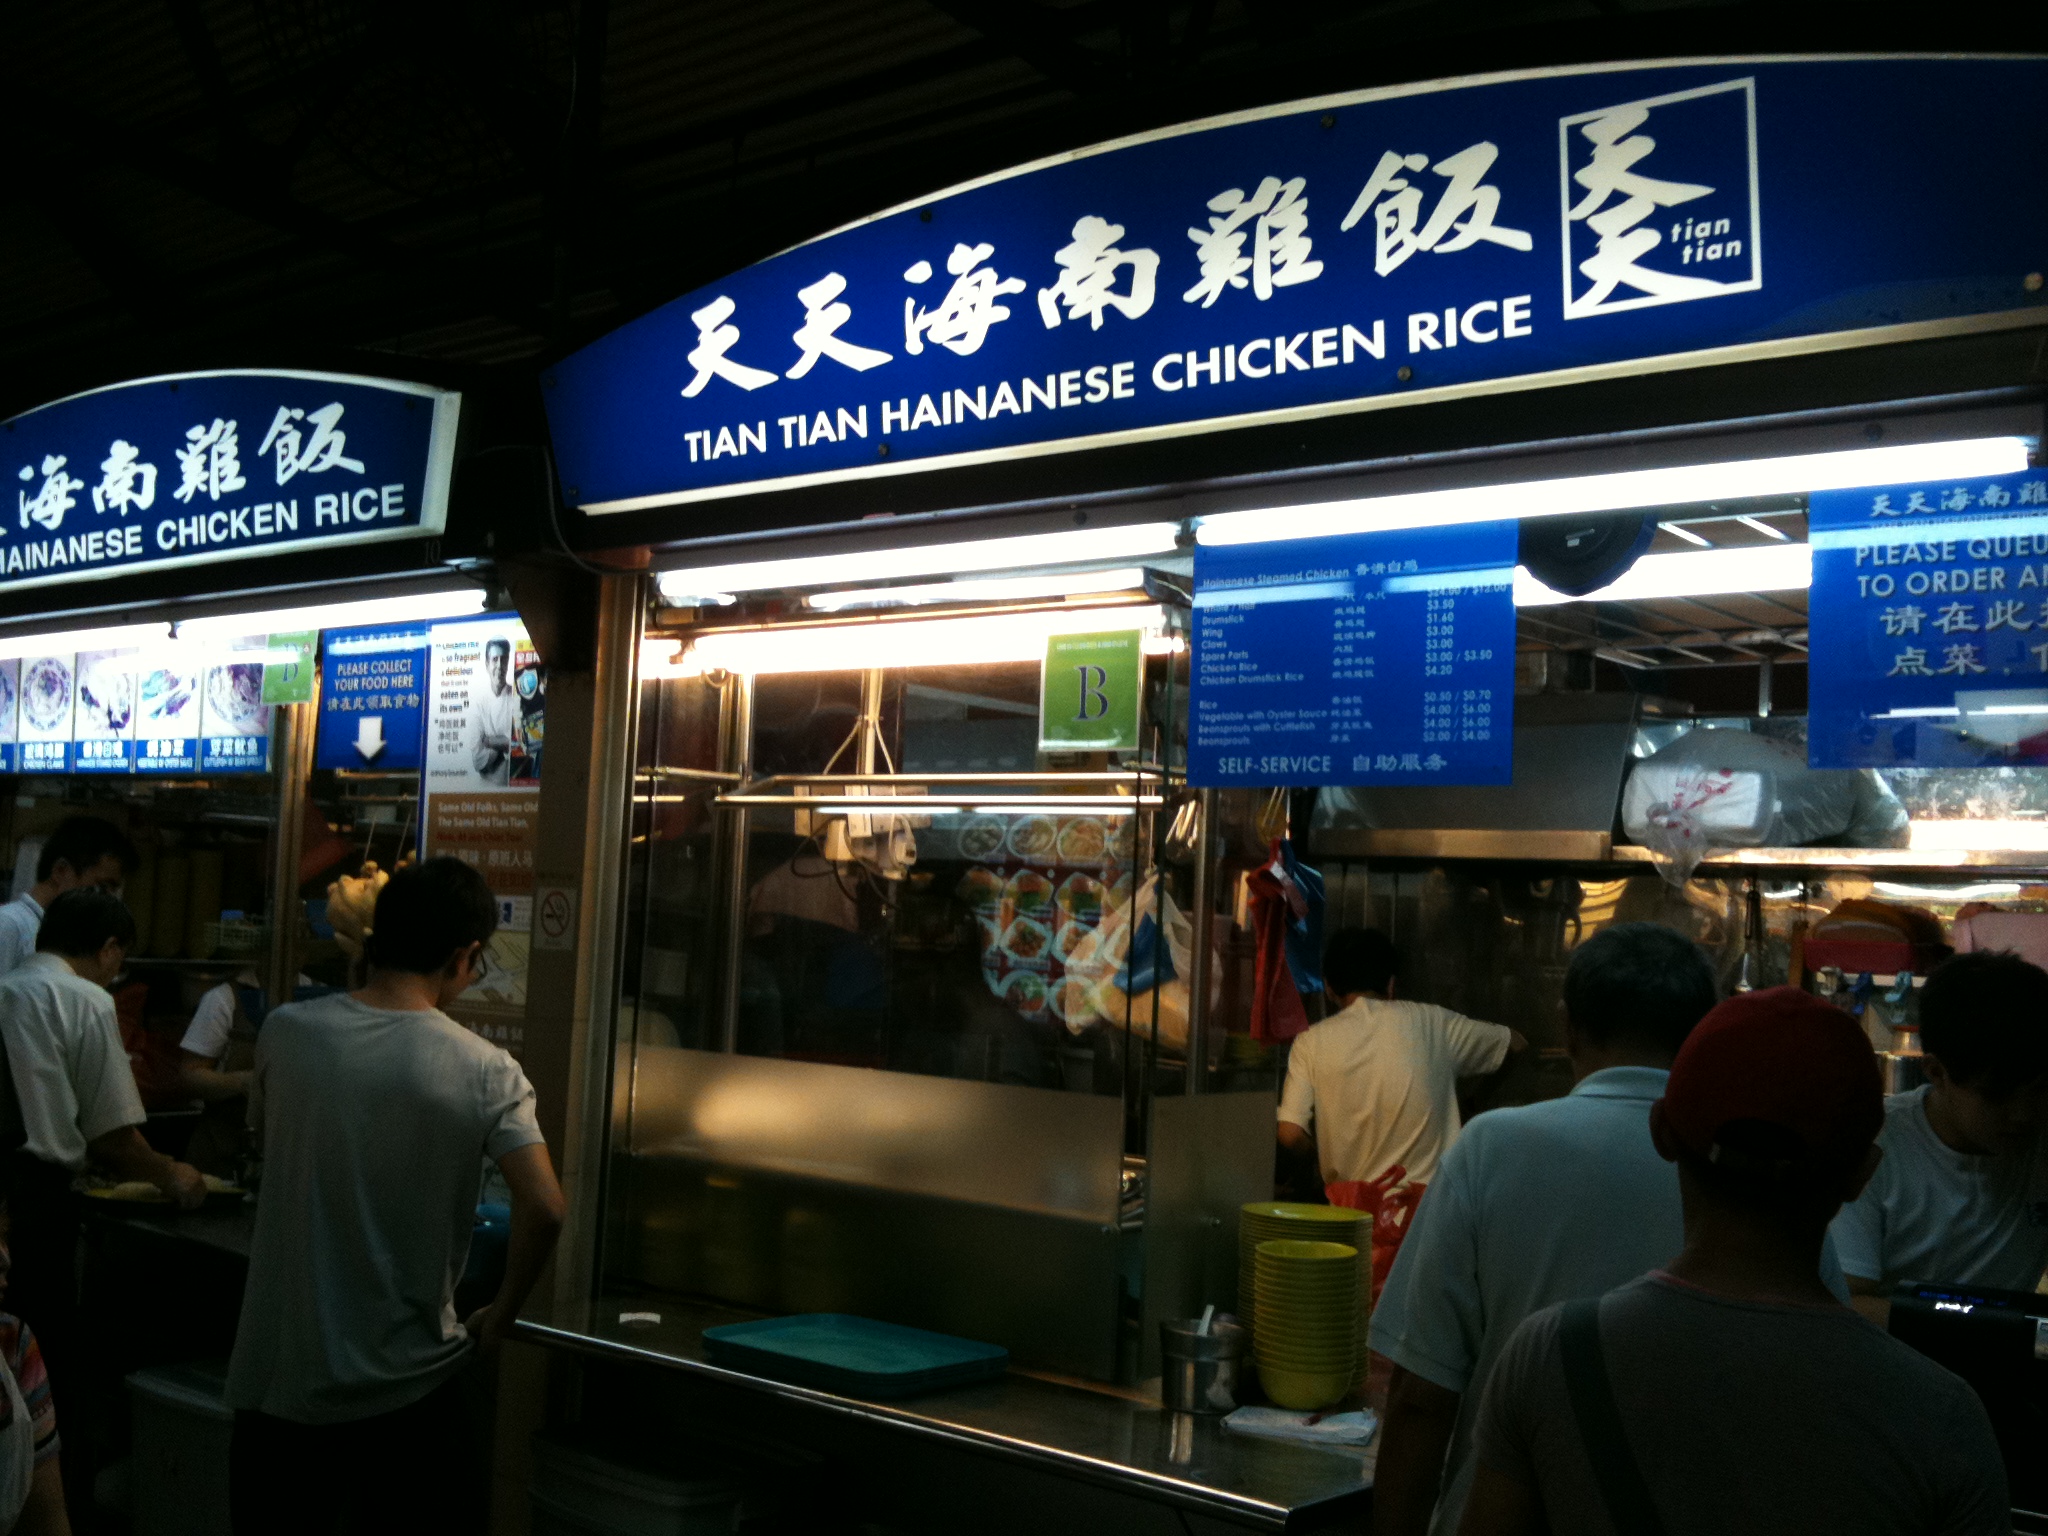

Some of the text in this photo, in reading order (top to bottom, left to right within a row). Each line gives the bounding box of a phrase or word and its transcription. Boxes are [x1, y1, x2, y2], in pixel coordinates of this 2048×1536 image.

[1671, 217, 1730, 243] tian
[1682, 239, 1742, 264] tian
[681, 141, 1533, 398] 天天海南雞飯
[684, 295, 1533, 463] TIAN TIAN HAINANESE CHICKEN RICE
[0, 402, 365, 536] 海南雞飯
[0, 484, 405, 575] AINANESE CHICKEN RICE
[1855, 541, 1956, 567] PLEASE
[1203, 575, 1254, 588] Hainanese
[1257, 571, 1302, 584] Steamed
[1305, 568, 1349, 580] Chicken
[1857, 572, 1895, 598] TO
[1906, 567, 2006, 595] ORDER
[1202, 614, 1244, 626] Drumstick
[1202, 628, 1223, 639] Wing
[1426, 625, 1454, 638] $3.00
[1201, 639, 1227, 649] Claws
[1425, 638, 1453, 651] $3.00
[1201, 650, 1249, 663] Spare Parts
[1425, 651, 1453, 664] $3.00
[337, 658, 413, 677] PLEASE COLLECT
[1200, 662, 1258, 674] Chicken Rice
[1425, 664, 1453, 677] $4.20
[335, 674, 414, 691] YOUR FOOD HERE
[1200, 672, 1305, 686] Chicken Drumstick Rice
[1072, 664, 1109, 722] B
[1199, 700, 1218, 710] Rice
[1424, 704, 1451, 716] $4.00
[1199, 711, 1244, 723] Vegetable
[1246, 710, 1265, 720] with
[1267, 709, 1296, 720] Oyster
[1299, 709, 1327, 719] Sauce
[1253, 722, 1271, 732] with
[1423, 718, 1451, 730] $4.00
[1461, 729, 1491, 742] $4.00
[1218, 755, 1331, 774] SELF-SERVICE
[438, 802, 460, 812] Same
[461, 801, 475, 812] Old
[501, 802, 523, 812] Same
[438, 816, 453, 827] The
[453, 817, 475, 827] Same
[476, 816, 490, 827] Old
